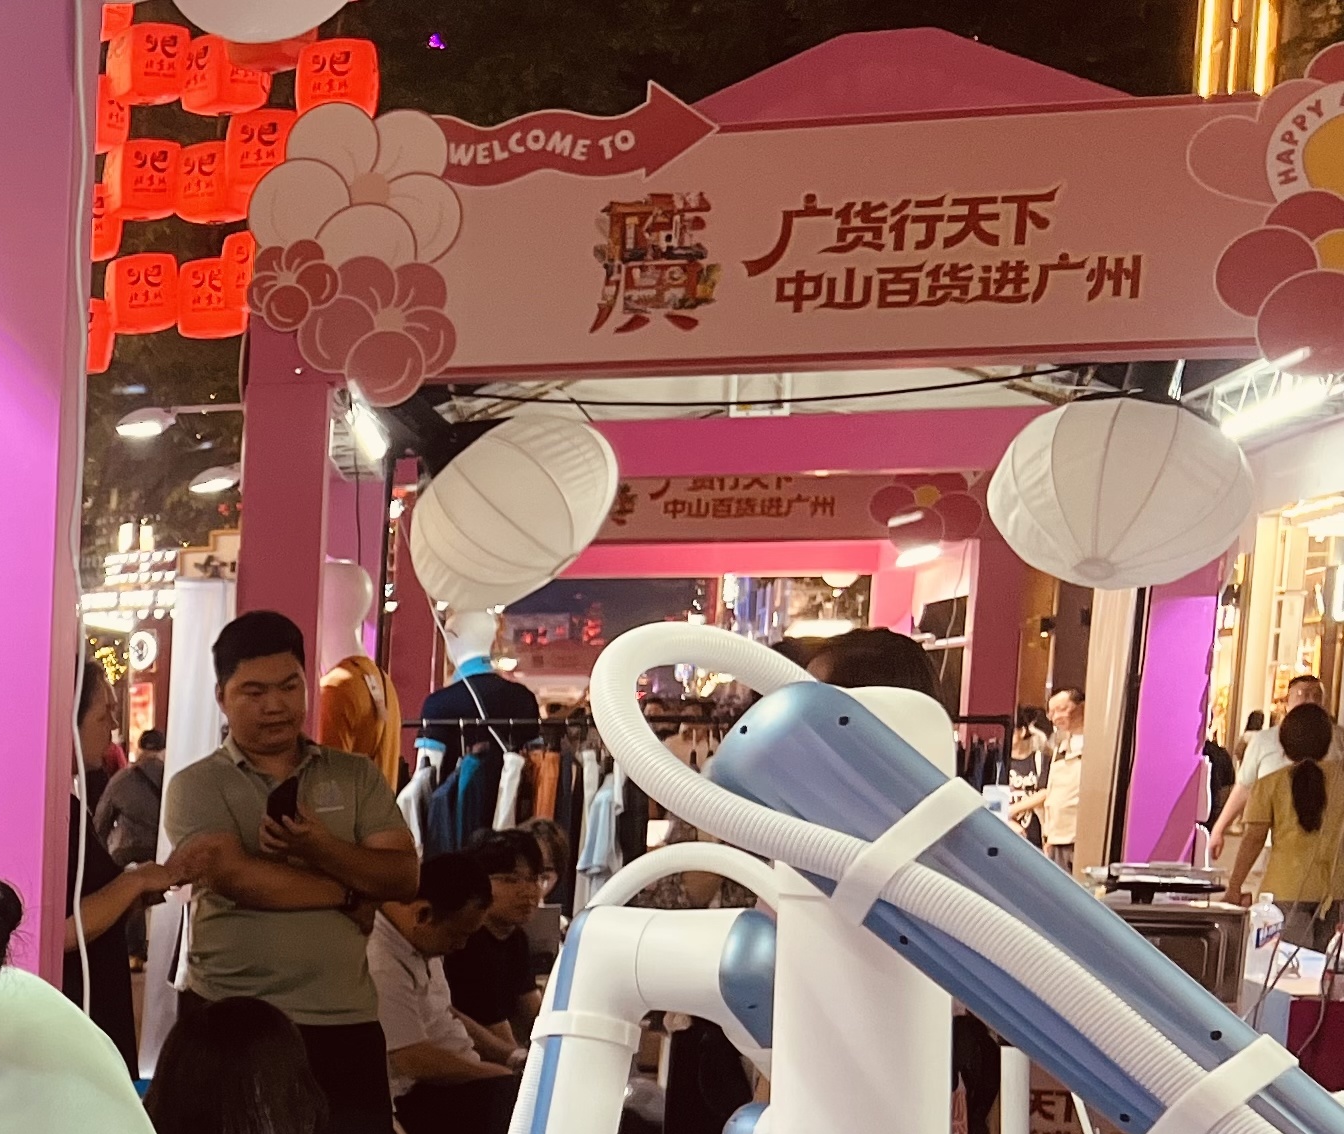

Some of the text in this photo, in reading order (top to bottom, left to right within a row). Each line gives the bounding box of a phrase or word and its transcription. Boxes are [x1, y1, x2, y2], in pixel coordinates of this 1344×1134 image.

[449, 129, 636, 167] WELCOME TO
[1276, 99, 1324, 186] HAPPY
[742, 185, 1061, 277] 广货行天下
[775, 252, 1142, 313] 中山百货进广州
